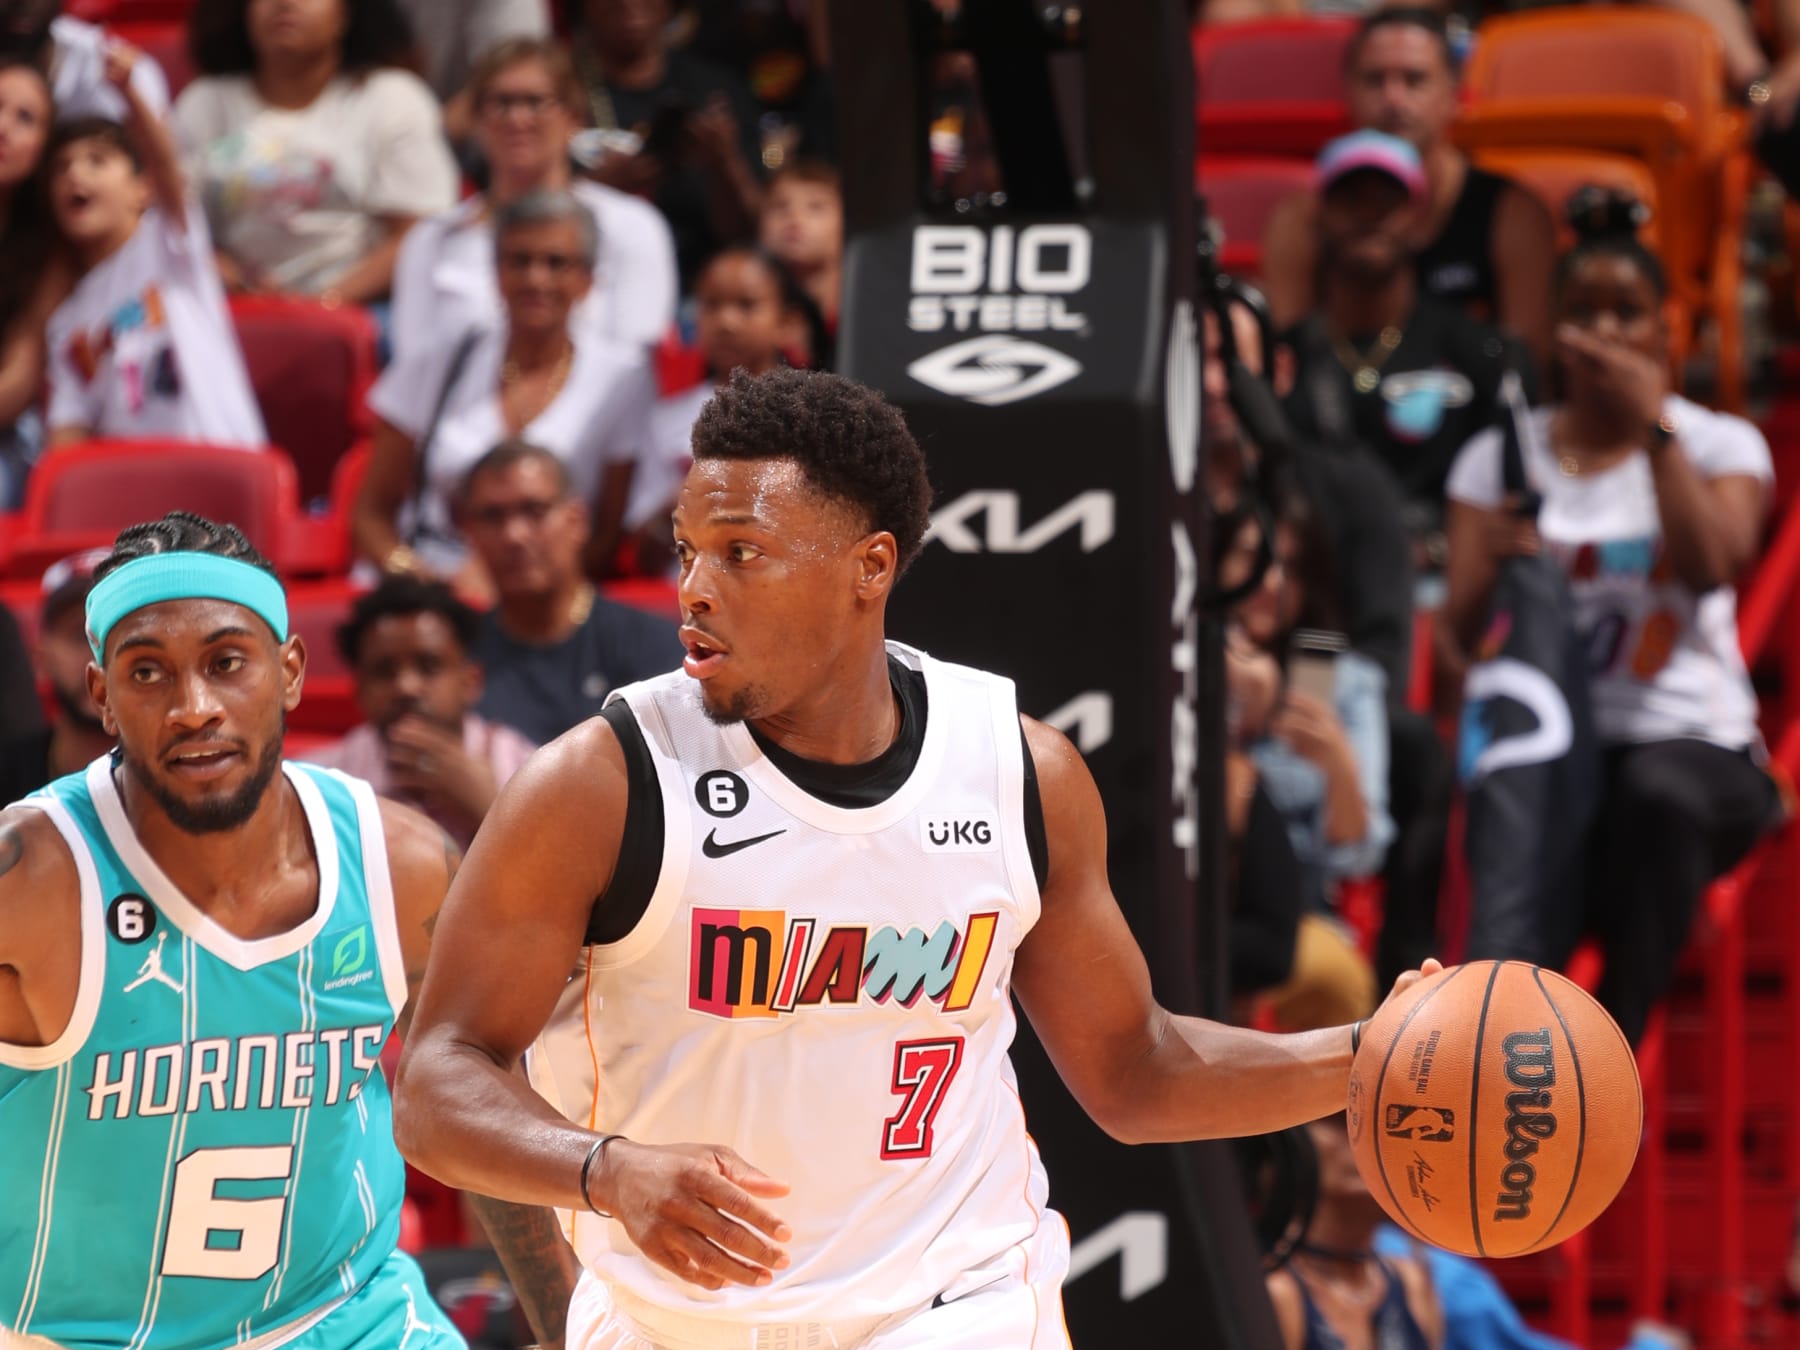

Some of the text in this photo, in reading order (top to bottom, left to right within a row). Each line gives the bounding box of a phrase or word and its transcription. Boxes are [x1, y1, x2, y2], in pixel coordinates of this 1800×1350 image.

[911, 224, 1092, 294] BIO
[908, 295, 1087, 332] STEEL
[707, 776, 737, 813] 6
[116, 900, 144, 939] 6
[86, 1024, 384, 1121] HORNETS
[1415, 1030, 1442, 1095] OFFICIAL GAME BALL
[880, 1036, 965, 1161] 7
[1493, 1027, 1557, 1222] Wilson
[160, 1144, 295, 1281] 6
